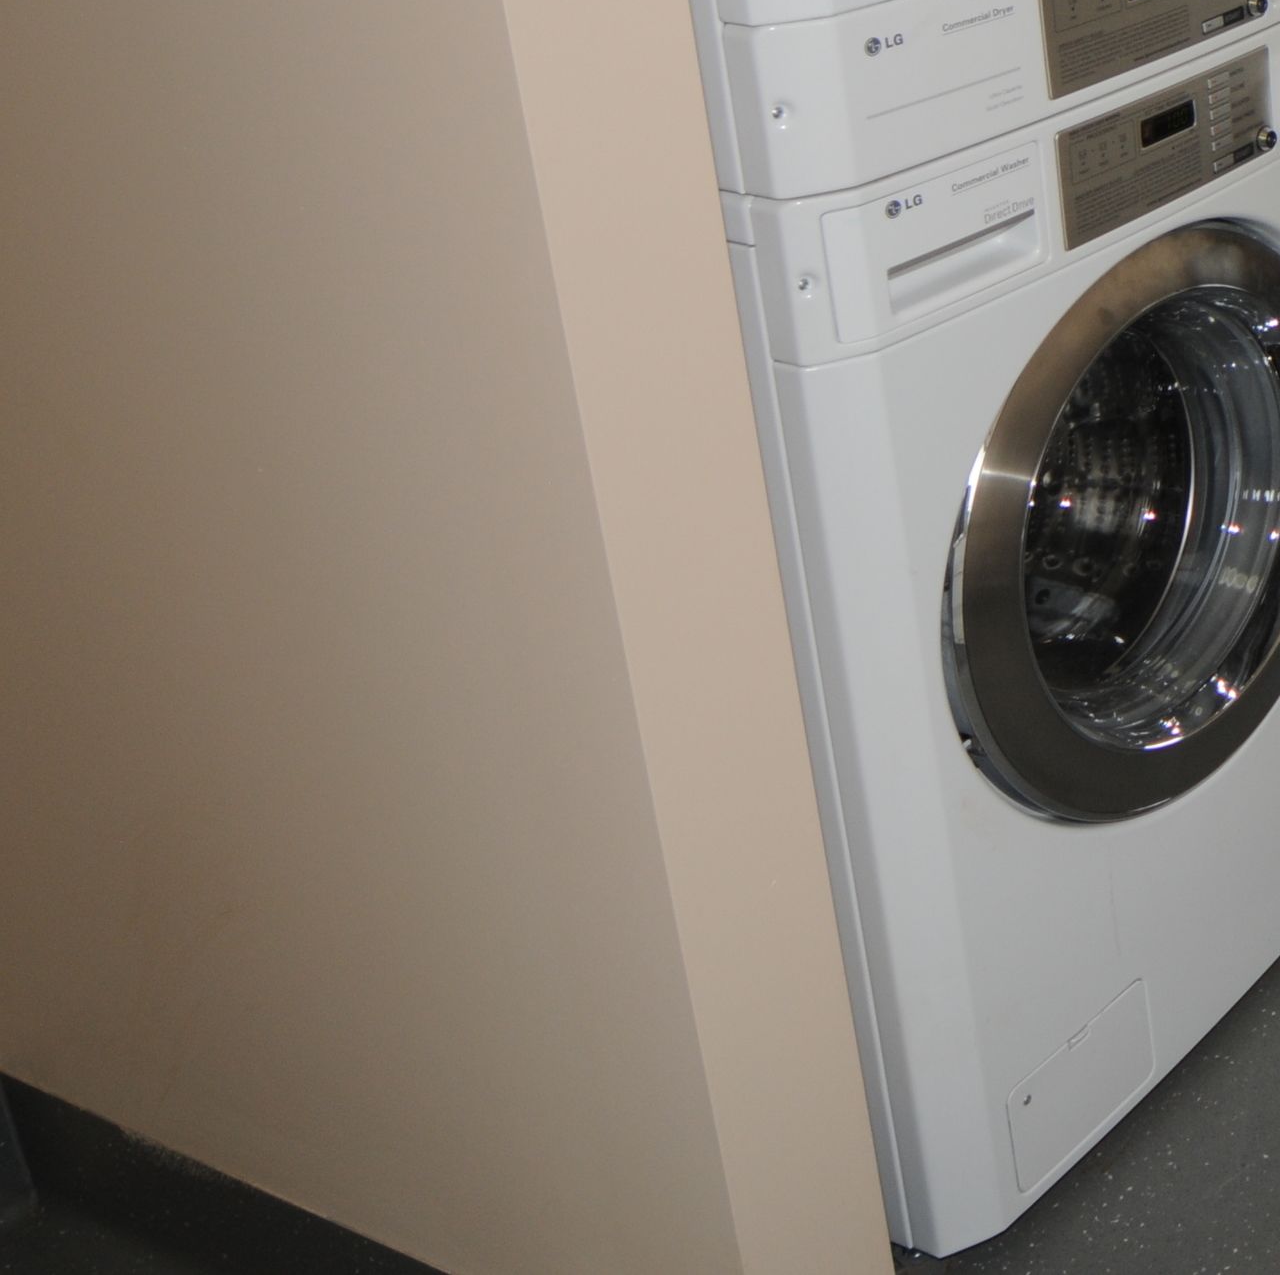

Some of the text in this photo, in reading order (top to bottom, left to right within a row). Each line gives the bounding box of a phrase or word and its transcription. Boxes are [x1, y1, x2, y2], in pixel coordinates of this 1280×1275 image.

[942, 5, 1014, 32] Commercial Dryer
[885, 33, 904, 49] LG
[951, 157, 1030, 192] Commercial Washer
[904, 194, 923, 210] LG
[983, 205, 1011, 224] Direct
[1011, 197, 1035, 213] Drive
